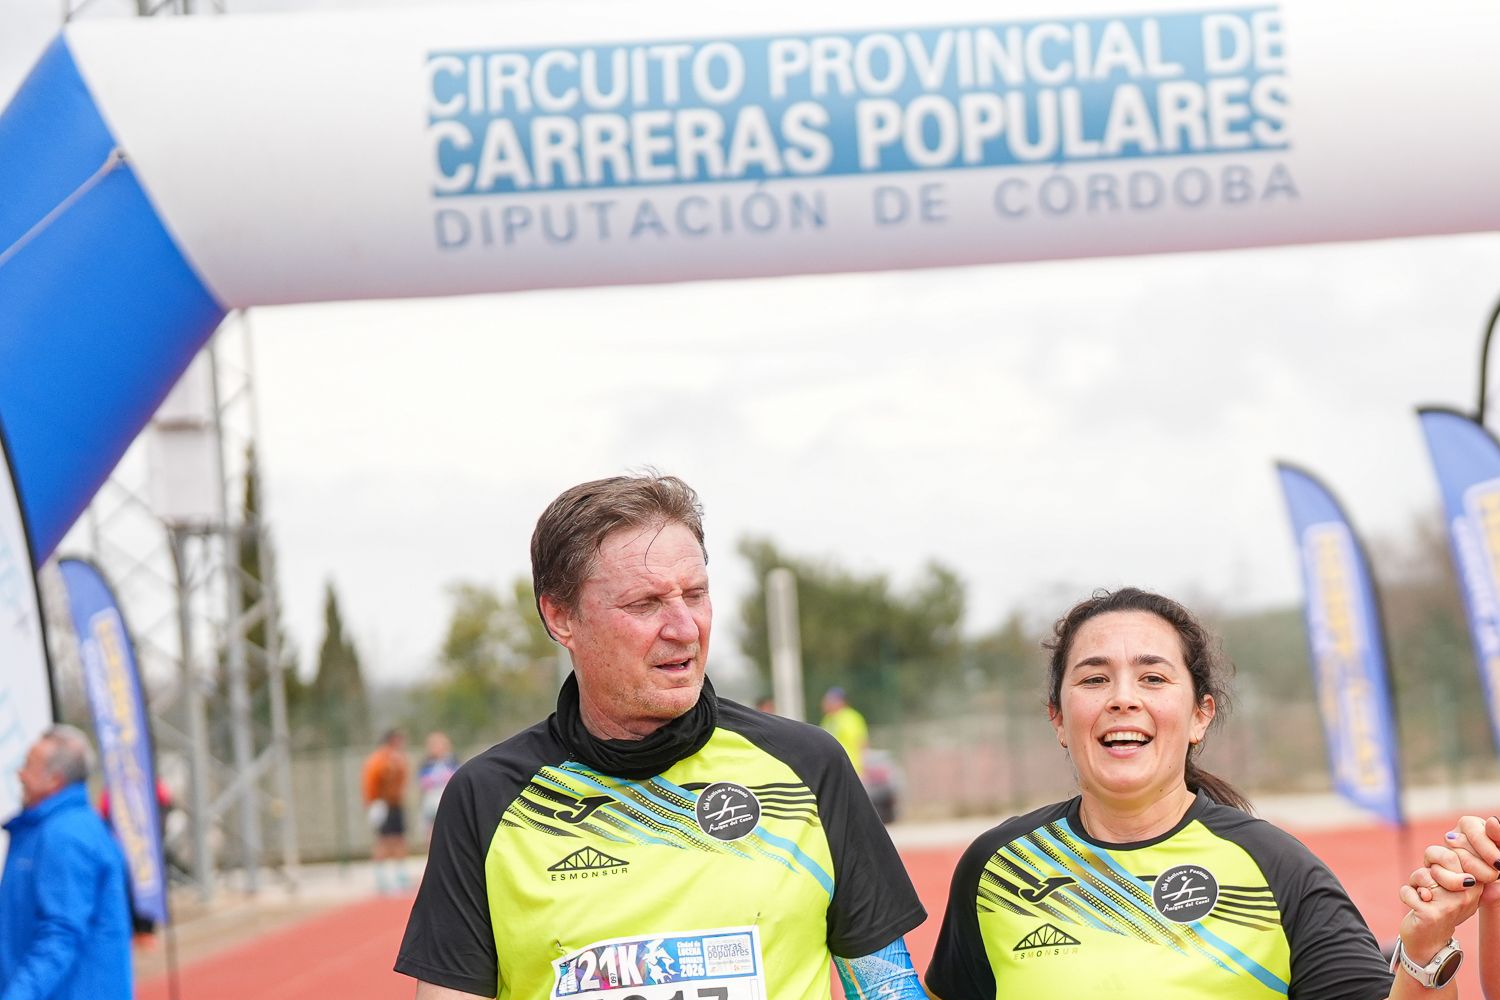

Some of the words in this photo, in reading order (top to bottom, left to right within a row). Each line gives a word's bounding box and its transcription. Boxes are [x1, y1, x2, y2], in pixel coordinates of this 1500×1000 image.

[426, 40, 747, 118] CIRCUITO
[767, 17, 1184, 99] PROVINCIAL
[1201, 9, 1287, 75] DE
[427, 100, 835, 193] CARRERAS
[856, 73, 1292, 170] POPULARES
[432, 181, 826, 250] DIPUTACIÓN
[872, 182, 949, 227] DE
[993, 162, 1299, 220] CÓRDOBA
[551, 867, 628, 882] ESMONSUR
[706, 942, 742, 953] carreras
[707, 948, 750, 960] populares
[1014, 947, 1078, 960] ESMONSUR
[578, 943, 643, 990] 21K
[680, 963, 706, 978] 2026
